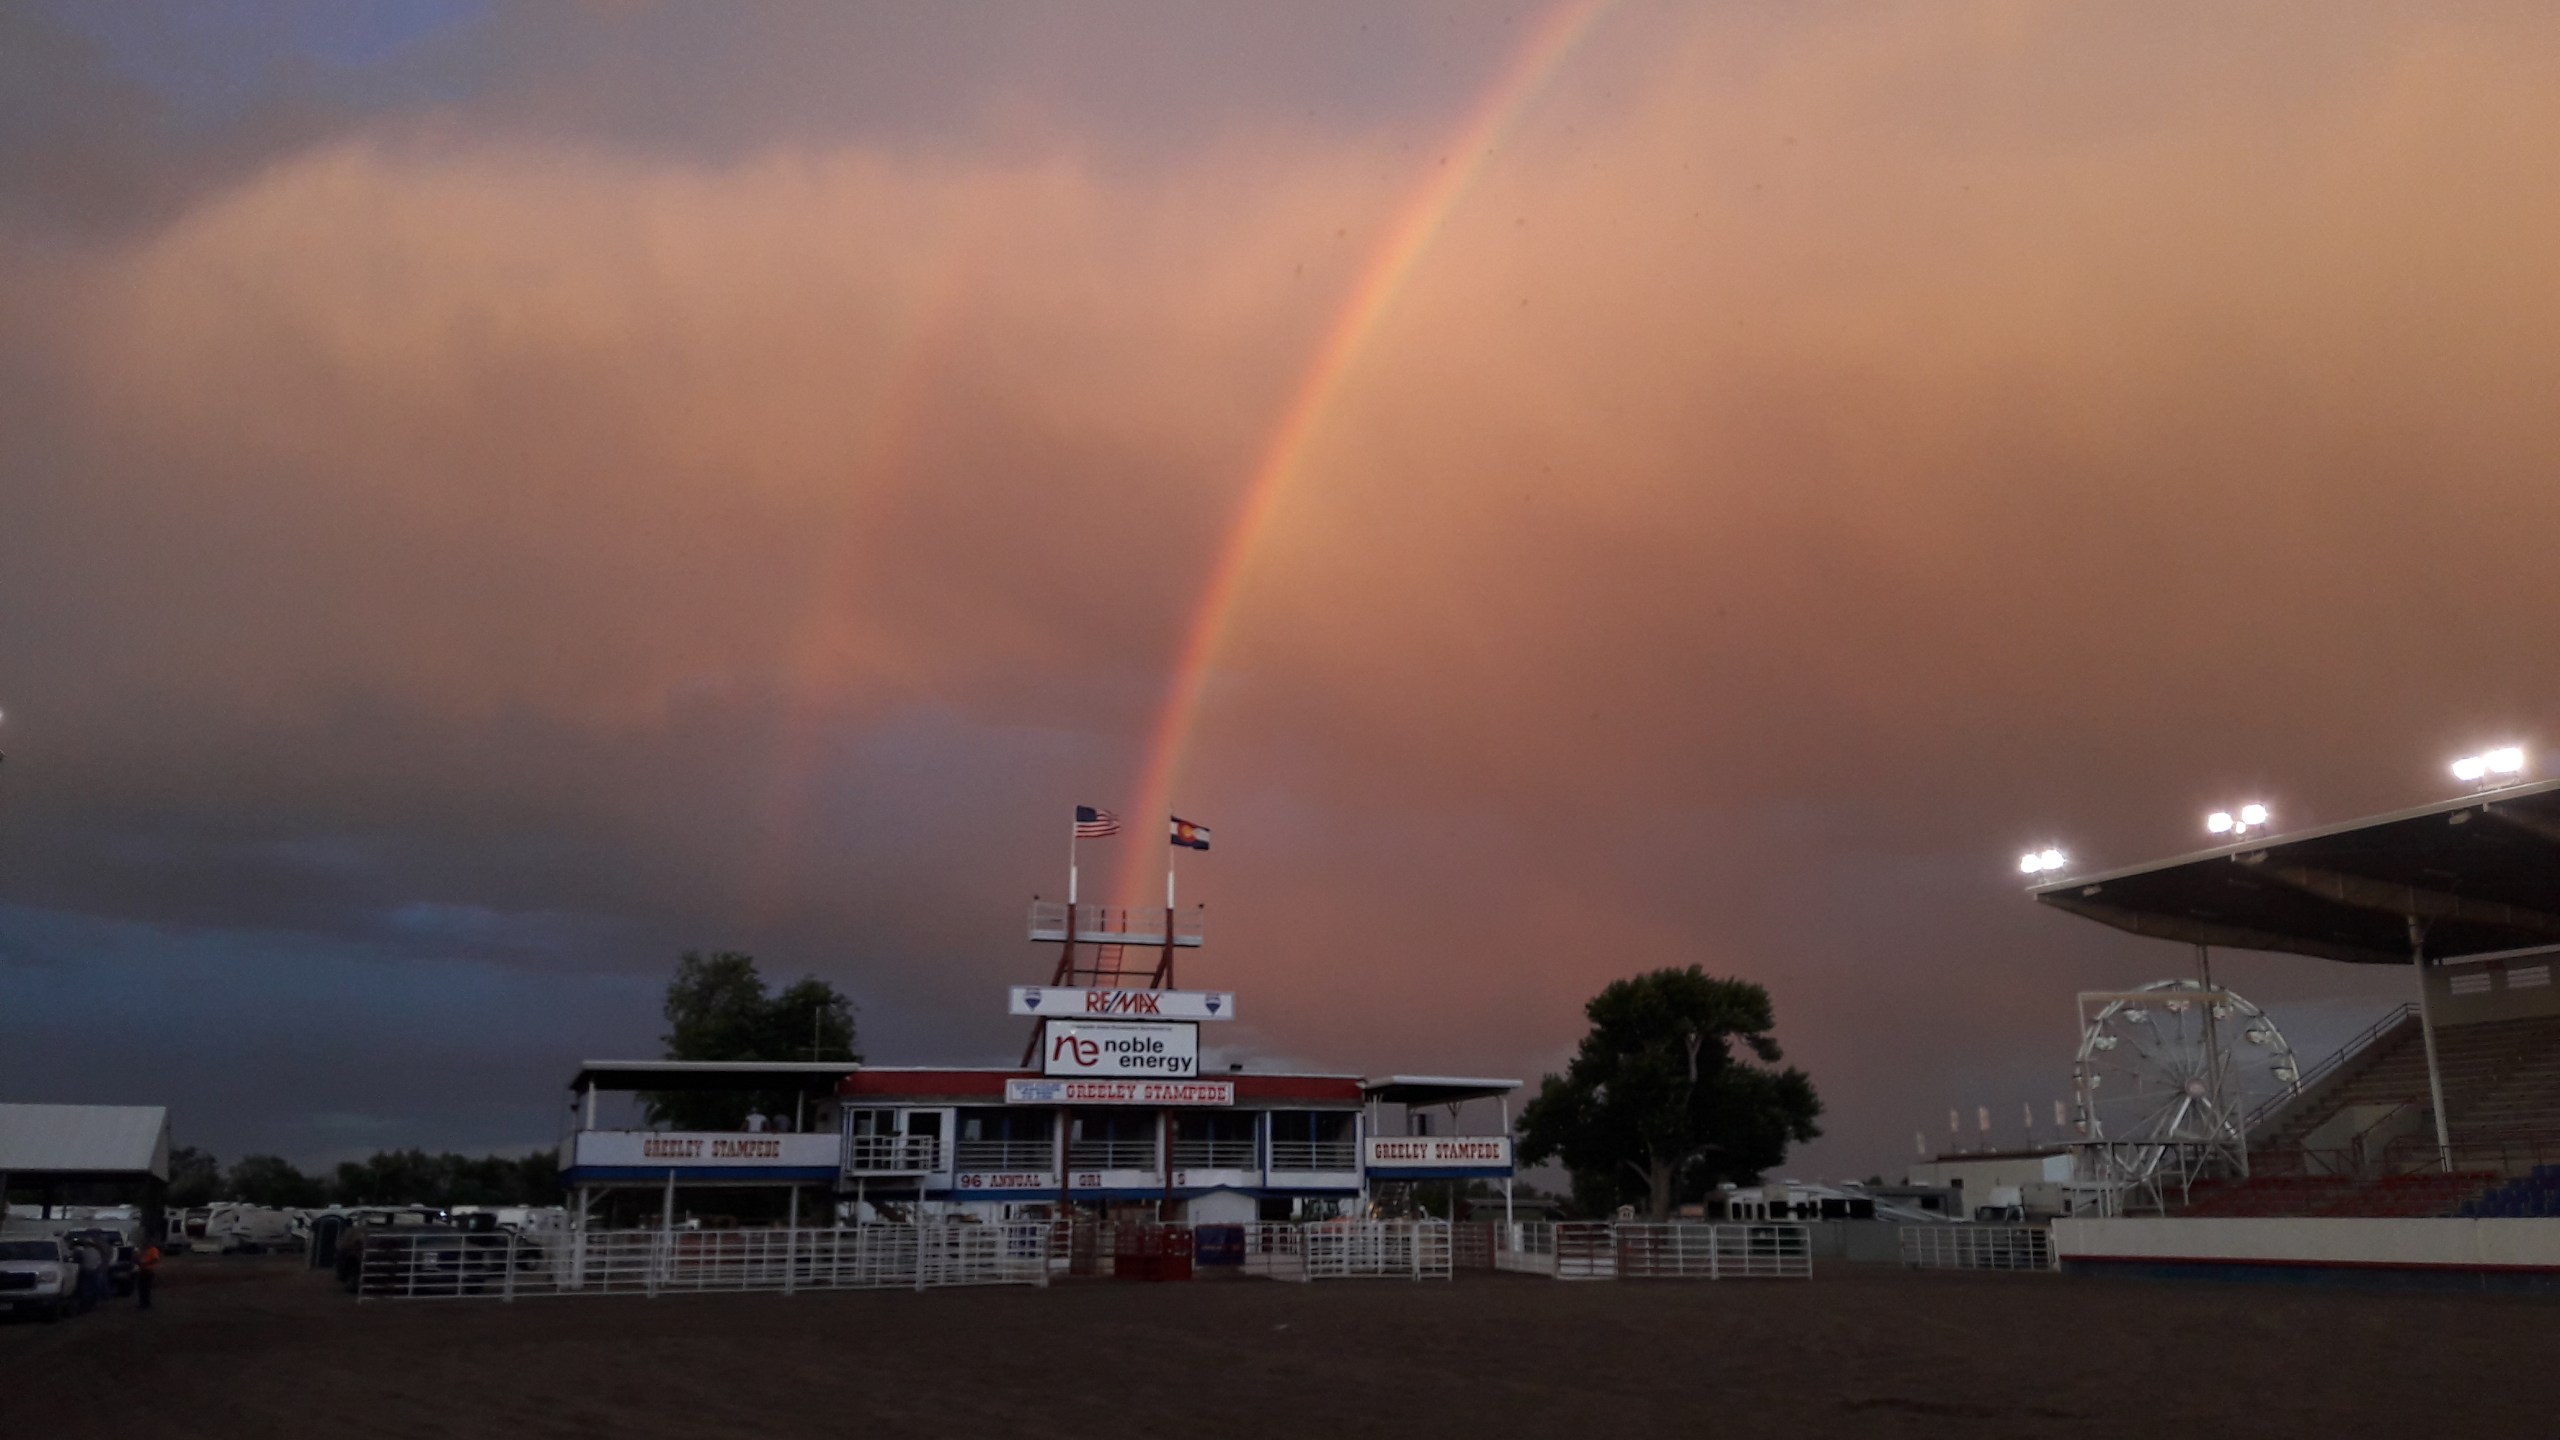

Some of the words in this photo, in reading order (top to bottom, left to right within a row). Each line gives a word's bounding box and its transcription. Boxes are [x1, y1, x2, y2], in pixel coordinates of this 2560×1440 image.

[1086, 990, 1160, 1014] RE/MAX
[1104, 1037, 1163, 1053] noble
[1119, 1054, 1192, 1072] energy
[1066, 1084, 1136, 1101] GREELEY
[1144, 1084, 1226, 1102] STAMPEDE
[643, 1139, 704, 1159] GREELEY
[711, 1139, 780, 1159] STAMPEDE
[1374, 1143, 1428, 1159] GREELEY
[1435, 1143, 1500, 1160] STAMPEDE
[961, 1175, 982, 1188] 96
[990, 1175, 1041, 1188] ANNUAL
